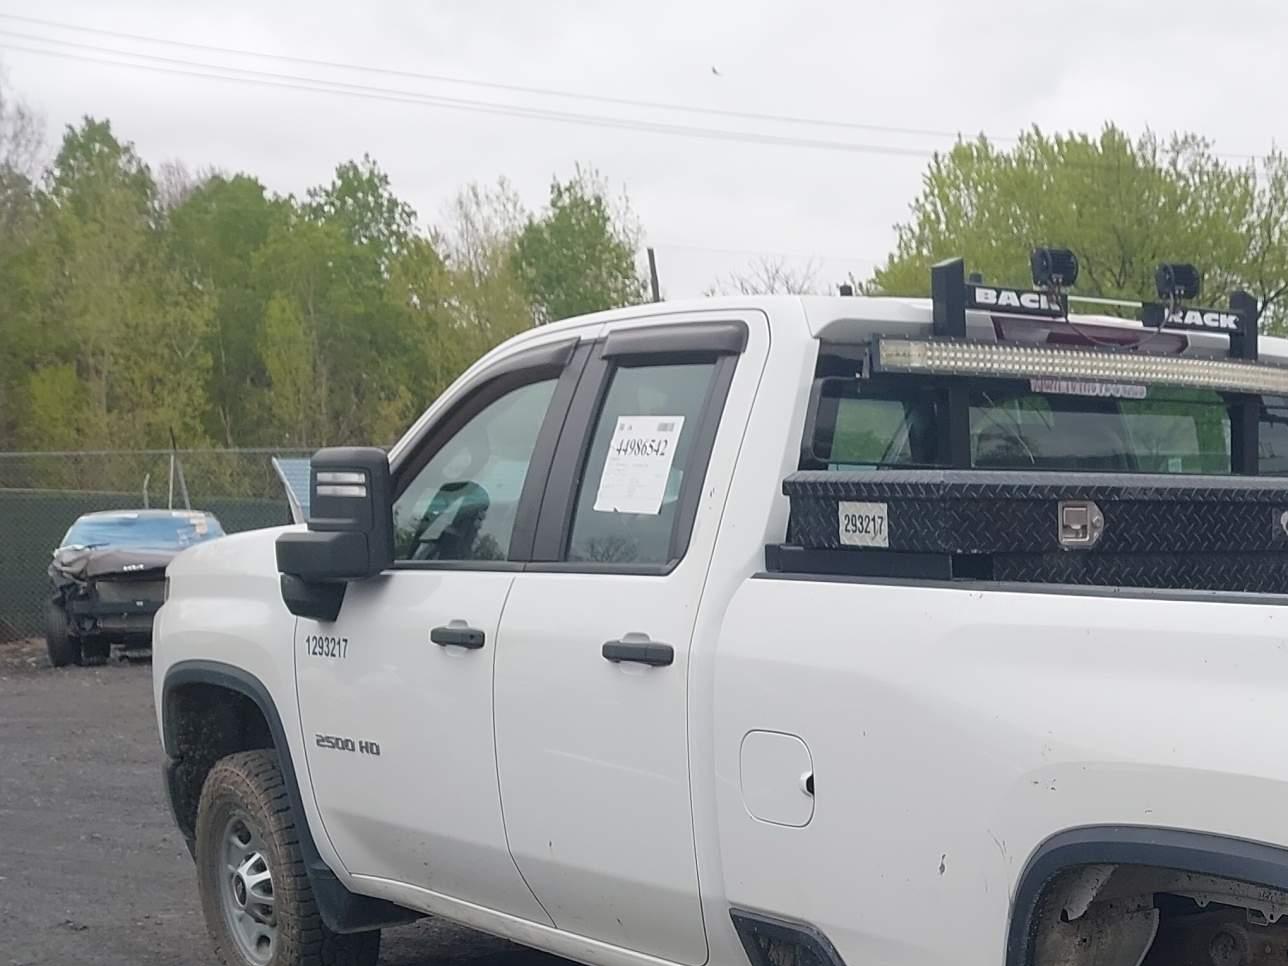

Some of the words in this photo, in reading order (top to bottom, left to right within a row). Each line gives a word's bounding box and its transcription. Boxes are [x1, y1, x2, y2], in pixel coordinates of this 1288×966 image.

[616, 438, 668, 456] 44986542
[844, 514, 884, 535] 293217
[305, 635, 348, 658] 1293217
[315, 734, 355, 752] 2500
[358, 740, 381, 756] HD
